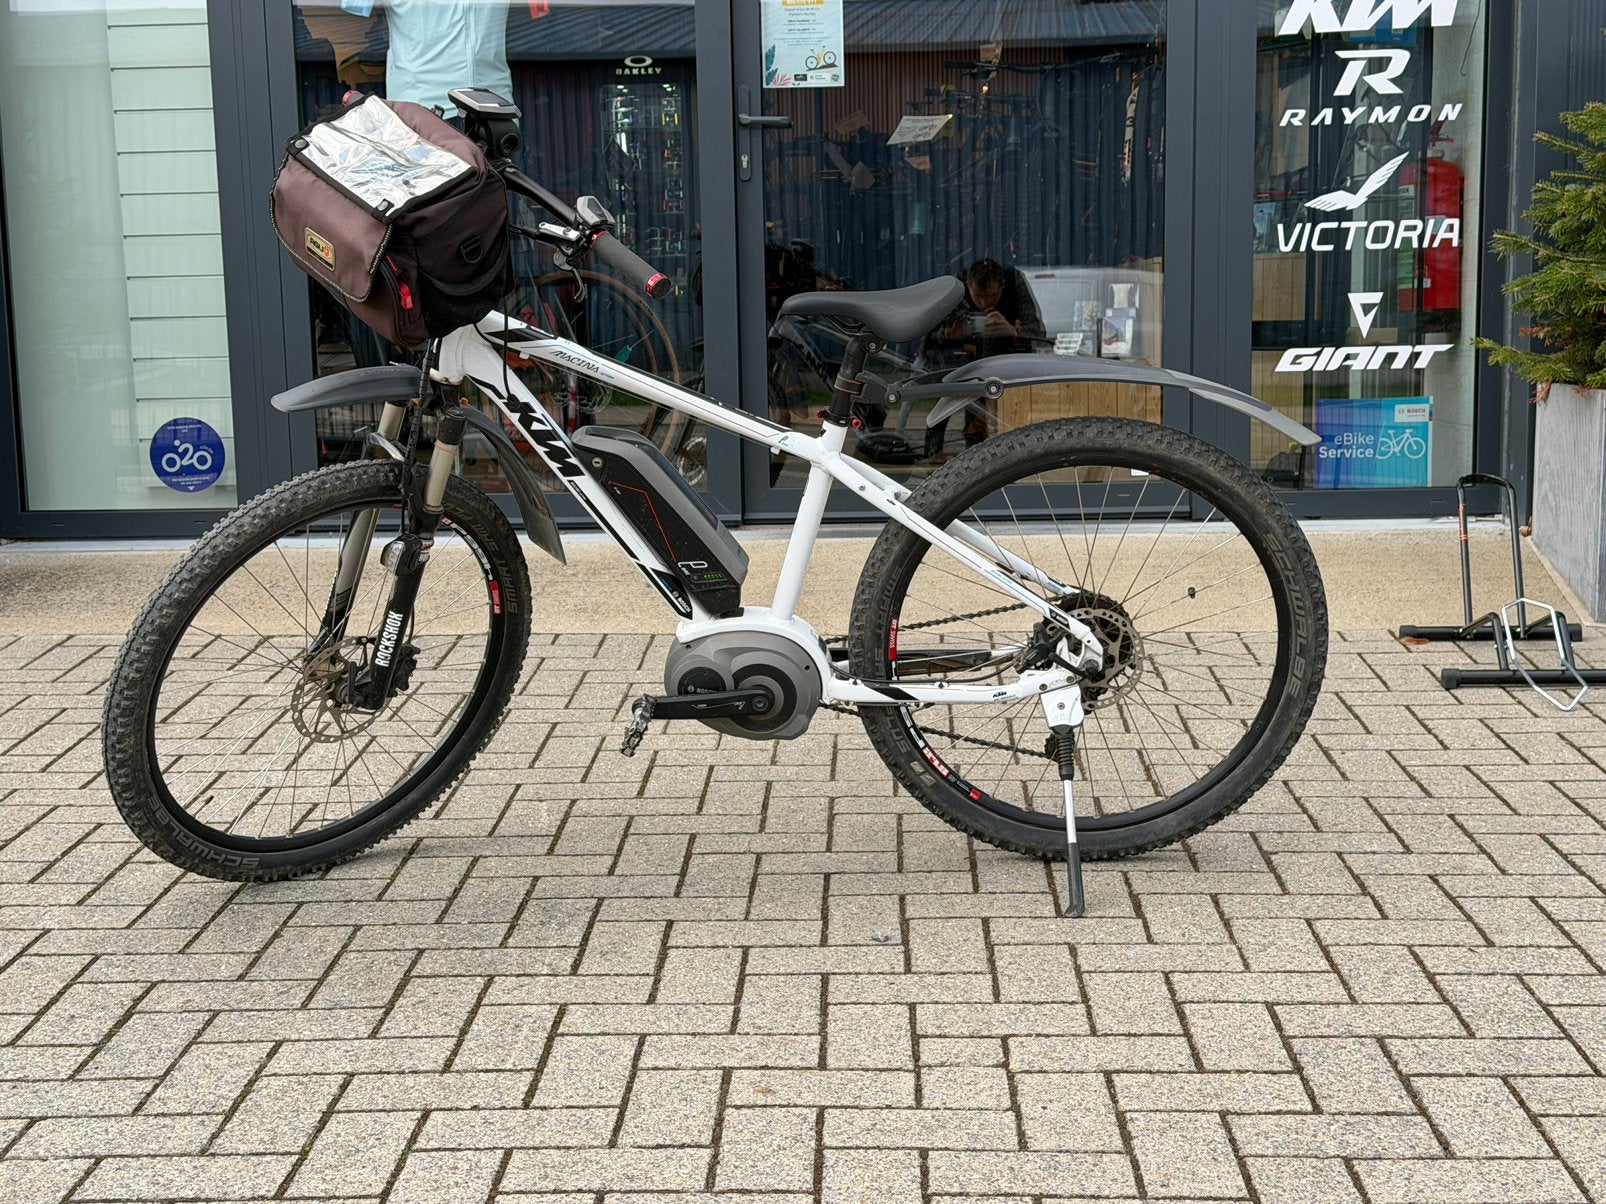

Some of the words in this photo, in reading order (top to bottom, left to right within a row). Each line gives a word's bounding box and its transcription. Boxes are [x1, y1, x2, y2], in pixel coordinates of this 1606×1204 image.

[615, 67, 662, 75] OAKLEY
[1279, 103, 1463, 127] RAYMON
[1277, 218, 1460, 252] VICTORIA
[549, 350, 600, 373] MACINA
[1274, 344, 1455, 372] GIANT
[501, 402, 585, 478] KTM
[1334, 432, 1375, 445] eBike
[1318, 446, 1374, 458] Service
[677, 597, 691, 612] BOSCH
[1263, 533, 1309, 697] SCHWALBE
[375, 610, 403, 667] ROCKSHOX
[145, 796, 260, 869] SCHWALBE
